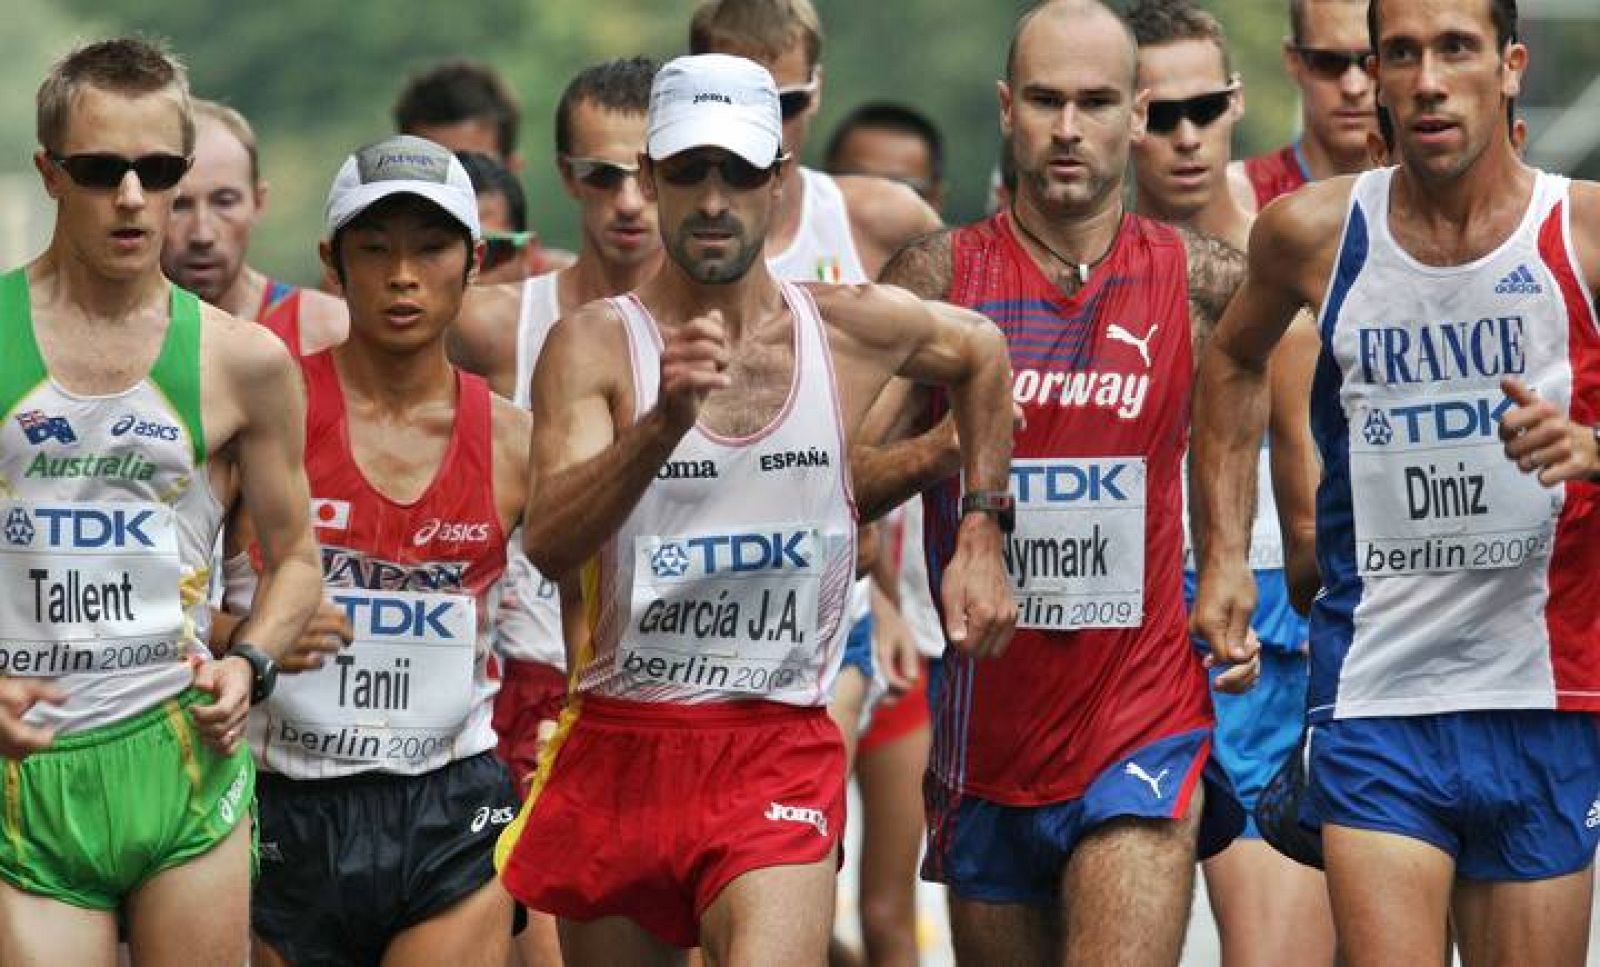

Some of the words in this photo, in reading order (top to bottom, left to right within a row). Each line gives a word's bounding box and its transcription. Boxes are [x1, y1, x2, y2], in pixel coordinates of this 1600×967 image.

[1495, 284, 1543, 294] adidas
[1359, 316, 1525, 384] FRANCE
[1010, 368, 1149, 418] orway
[135, 424, 180, 441] asics
[24, 451, 156, 480] Australia
[658, 460, 718, 479] oma
[761, 446, 829, 472] ESPAÑA
[1010, 464, 1127, 502] TDK
[1405, 462, 1488, 520] Diniz
[35, 508, 155, 547] TDK
[438, 522, 489, 541] asics
[688, 531, 810, 573] TDK
[1366, 540, 1465, 571] berlin
[1473, 537, 1537, 566] 2009
[28, 568, 135, 623] Tallent
[1070, 601, 1132, 625] 2009
[331, 595, 455, 638] TDK
[639, 590, 740, 639] García
[748, 590, 804, 643] J.A.
[100, 642, 168, 669] 2009
[623, 651, 729, 688] berlin
[336, 655, 410, 710] Tanii
[280, 723, 380, 757] berlin
